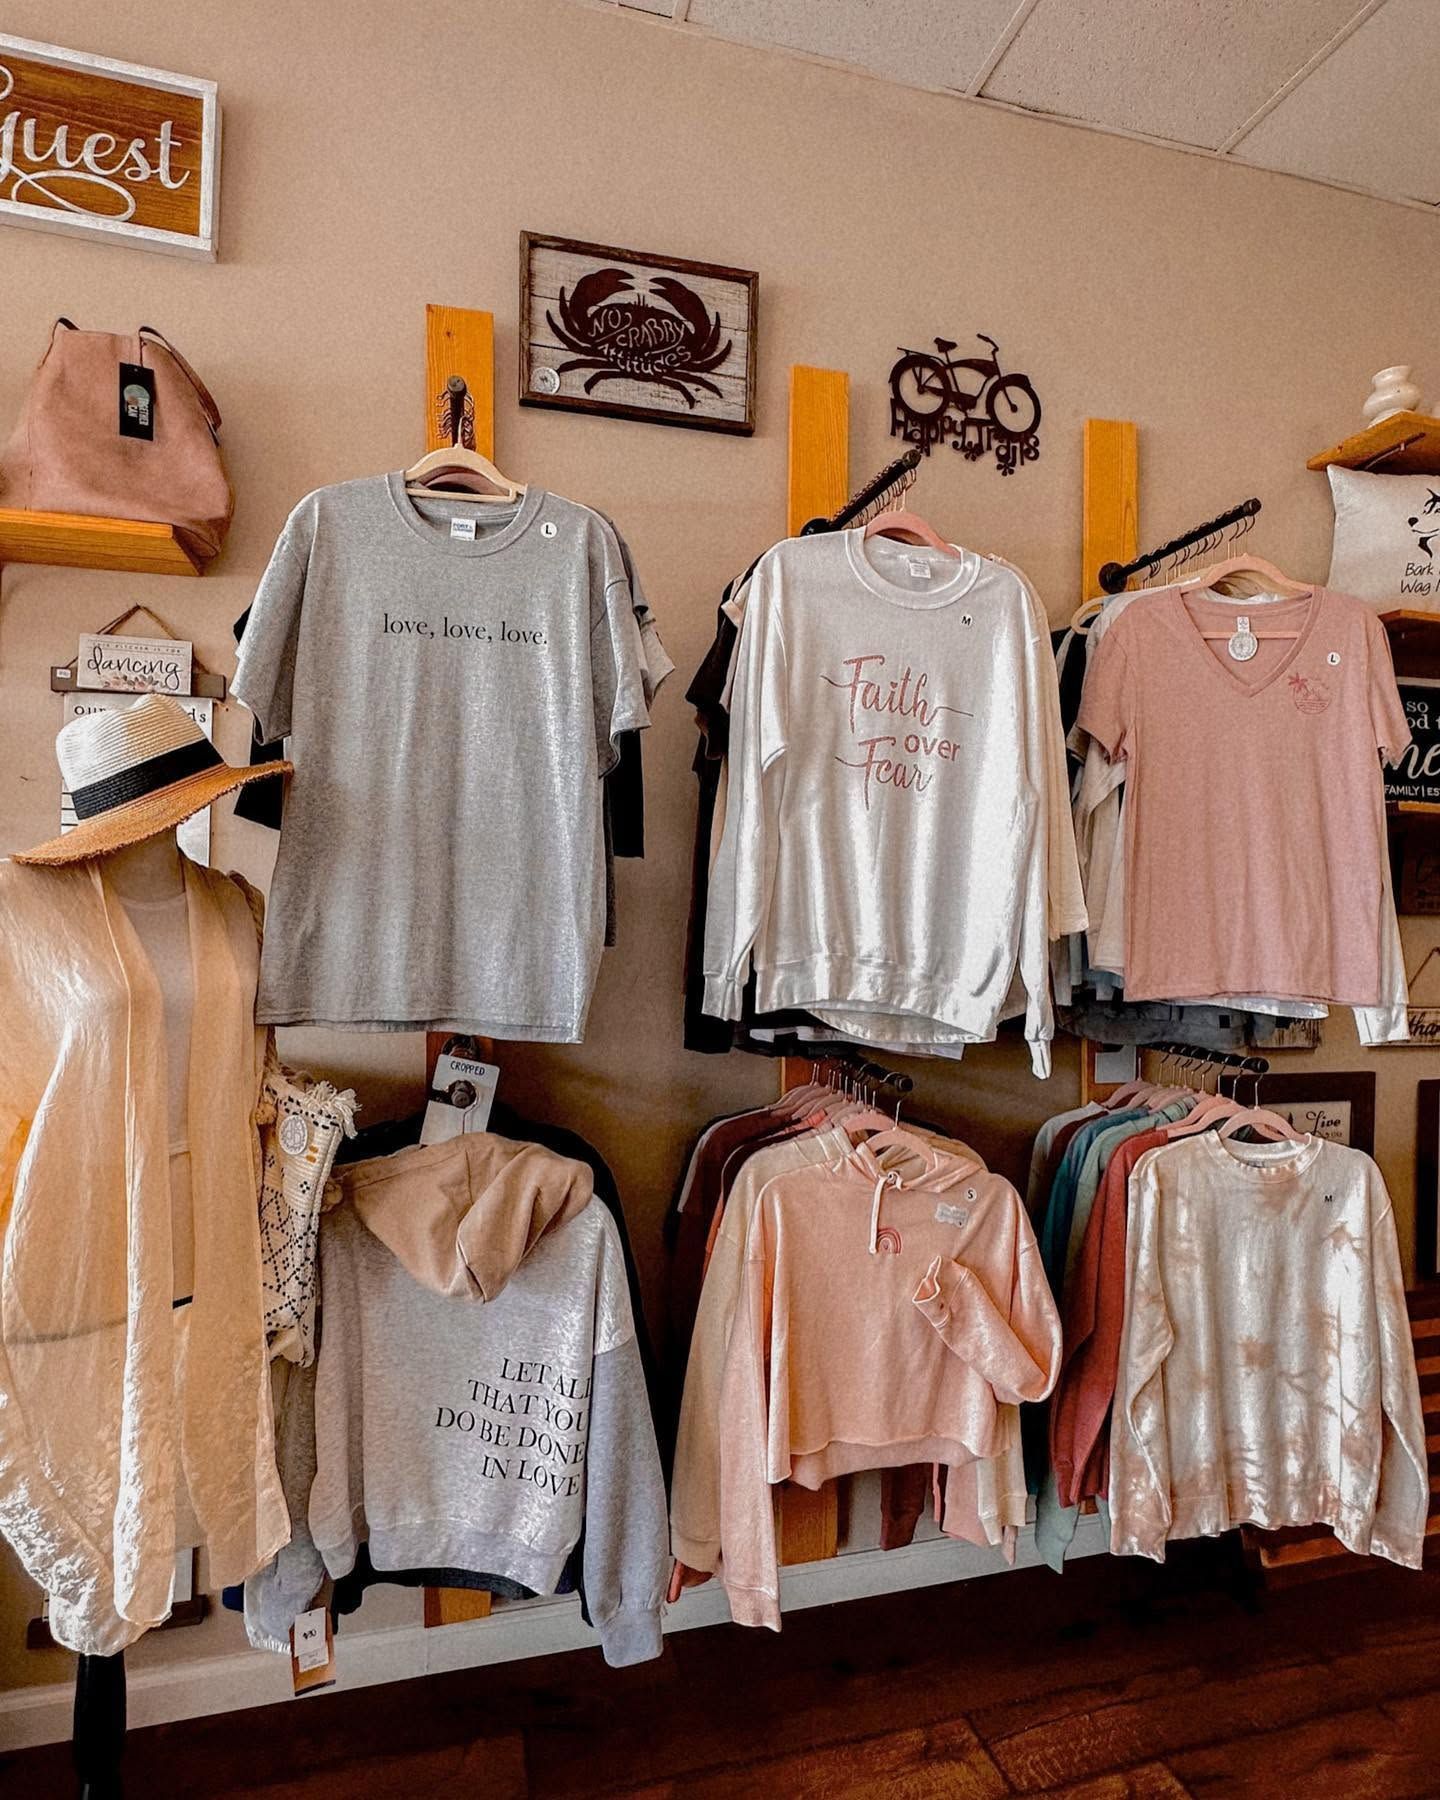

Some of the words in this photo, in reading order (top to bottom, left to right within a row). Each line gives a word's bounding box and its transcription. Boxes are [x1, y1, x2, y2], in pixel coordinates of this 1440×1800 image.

[588, 308, 632, 338] NO
[616, 318, 686, 354] CRABBY
[890, 398, 967, 457] Happy
[545, 524, 552, 535] L
[1405, 562, 1434, 577] Bark
[1400, 579, 1431, 596] Wag
[383, 613, 435, 640] love,
[443, 616, 492, 643] love,
[500, 620, 548, 645] love.
[961, 616, 971, 626] M
[87, 646, 182, 691] dancing
[820, 654, 974, 734] Faith
[904, 734, 960, 761] over
[835, 736, 933, 811] Fear
[1384, 784, 1420, 797] FAMILY
[450, 1060, 486, 1076] CROPPED
[967, 1189, 974, 1200] S
[500, 1357, 552, 1384] LET
[468, 1379, 539, 1415] THAT
[435, 1406, 476, 1432] DO
[480, 1417, 511, 1447] BE
[517, 1426, 585, 1465] DONE
[481, 1454, 510, 1480] IN
[517, 1459, 580, 1497] LOVE
